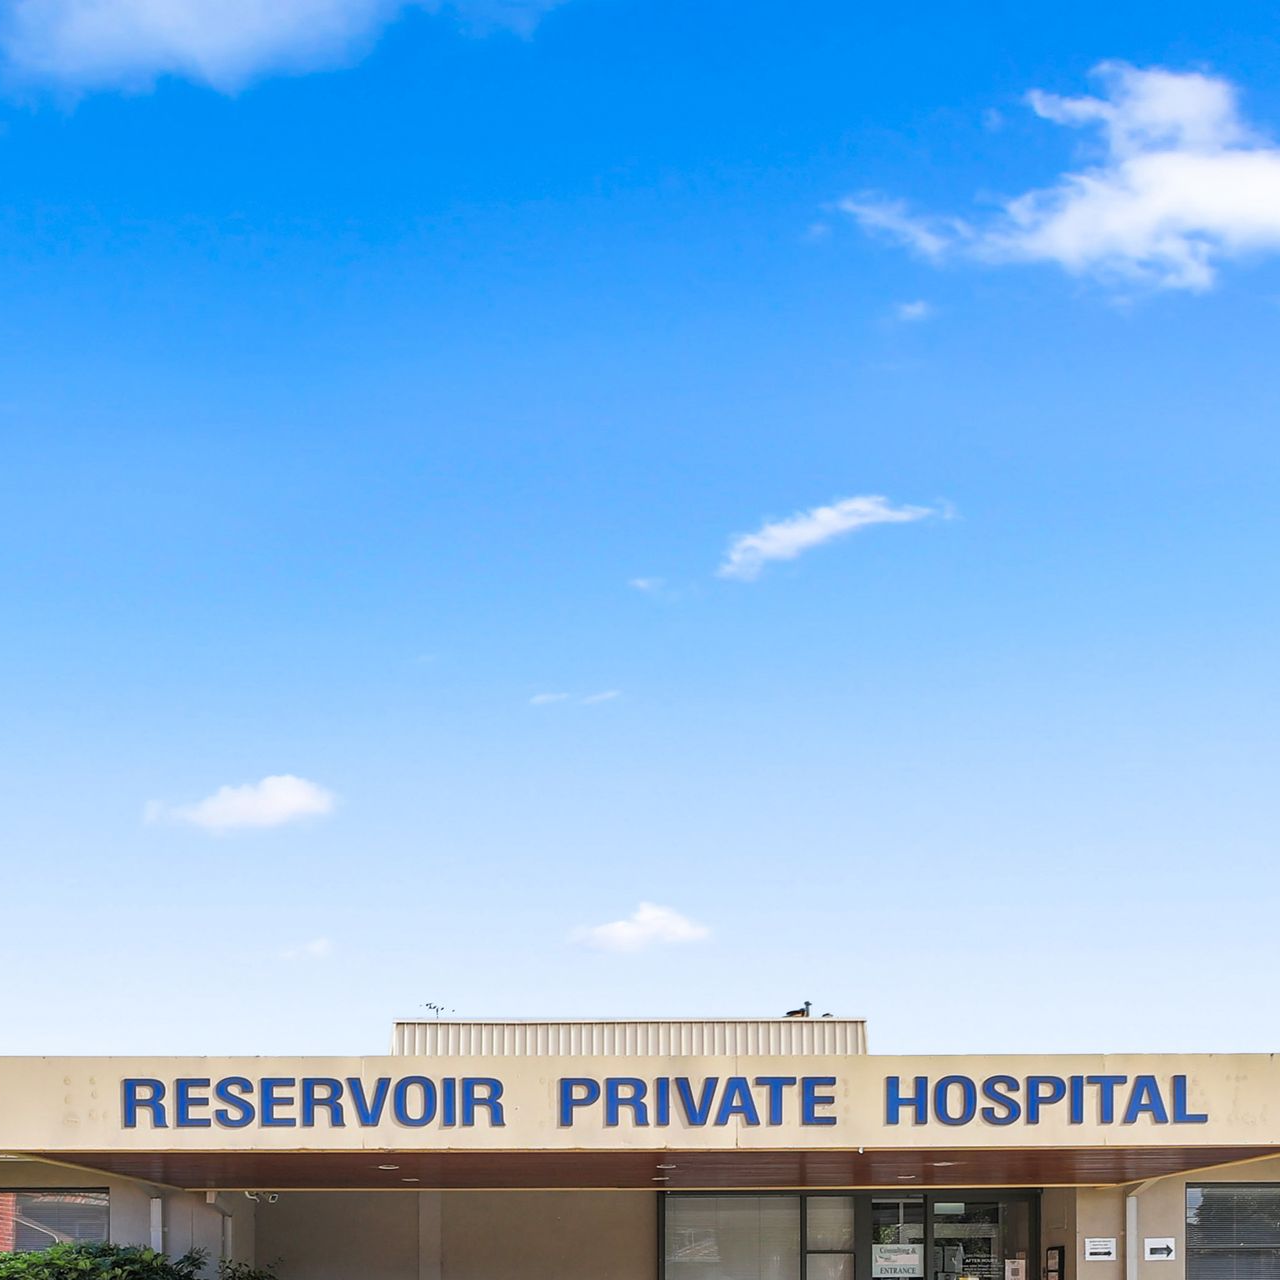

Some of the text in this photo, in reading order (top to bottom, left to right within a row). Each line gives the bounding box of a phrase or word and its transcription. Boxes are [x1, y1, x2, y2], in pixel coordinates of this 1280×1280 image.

[122, 1074, 1209, 1129] RESERVOIR PRIVATE HOSPITAL
[880, 1266, 917, 1274] ENTRANCE
